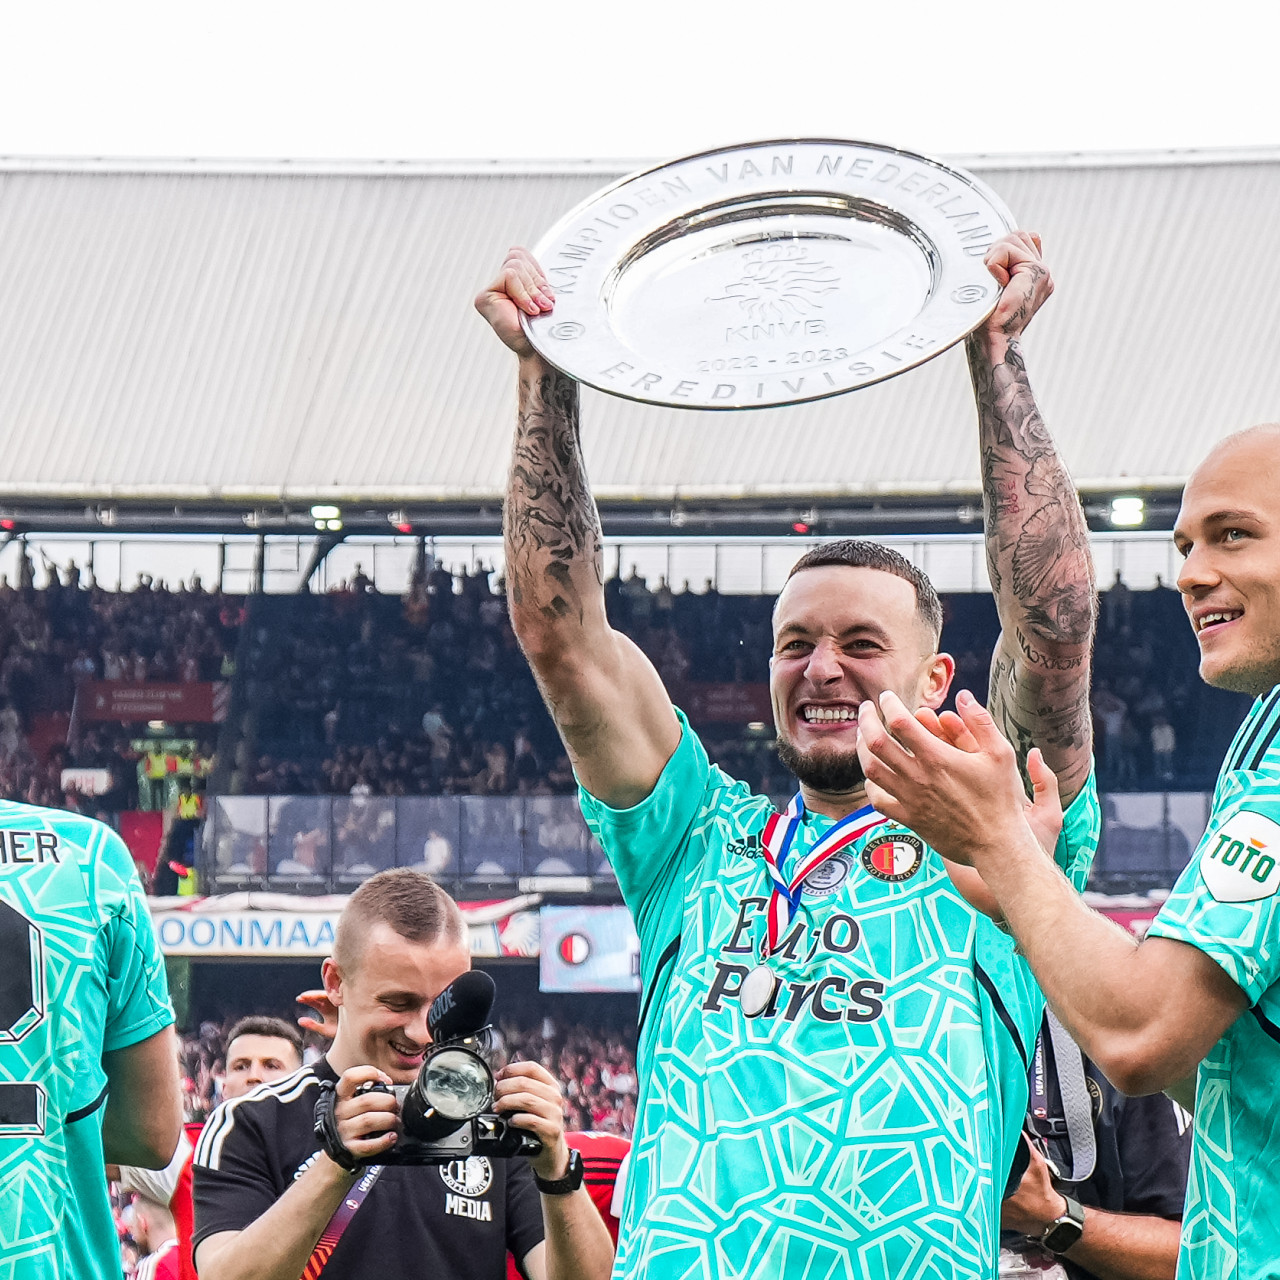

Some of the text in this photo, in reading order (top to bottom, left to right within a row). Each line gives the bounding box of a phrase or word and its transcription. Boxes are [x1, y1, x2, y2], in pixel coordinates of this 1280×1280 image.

[552, 153, 990, 295] KAMPIOEN VAN NEDERLAND
[724, 318, 828, 344] KNVB
[599, 332, 938, 401] EREDIVISIE
[696, 353, 759, 373] 2022
[784, 346, 850, 367] 2023
[865, 835, 920, 852] FEYENOORD
[866, 859, 920, 881] ROTTERDAM
[1210, 833, 1277, 884] TOTO
[1035, 1074, 1044, 1096] UEFA
[445, 1192, 492, 1222] MEDIA
